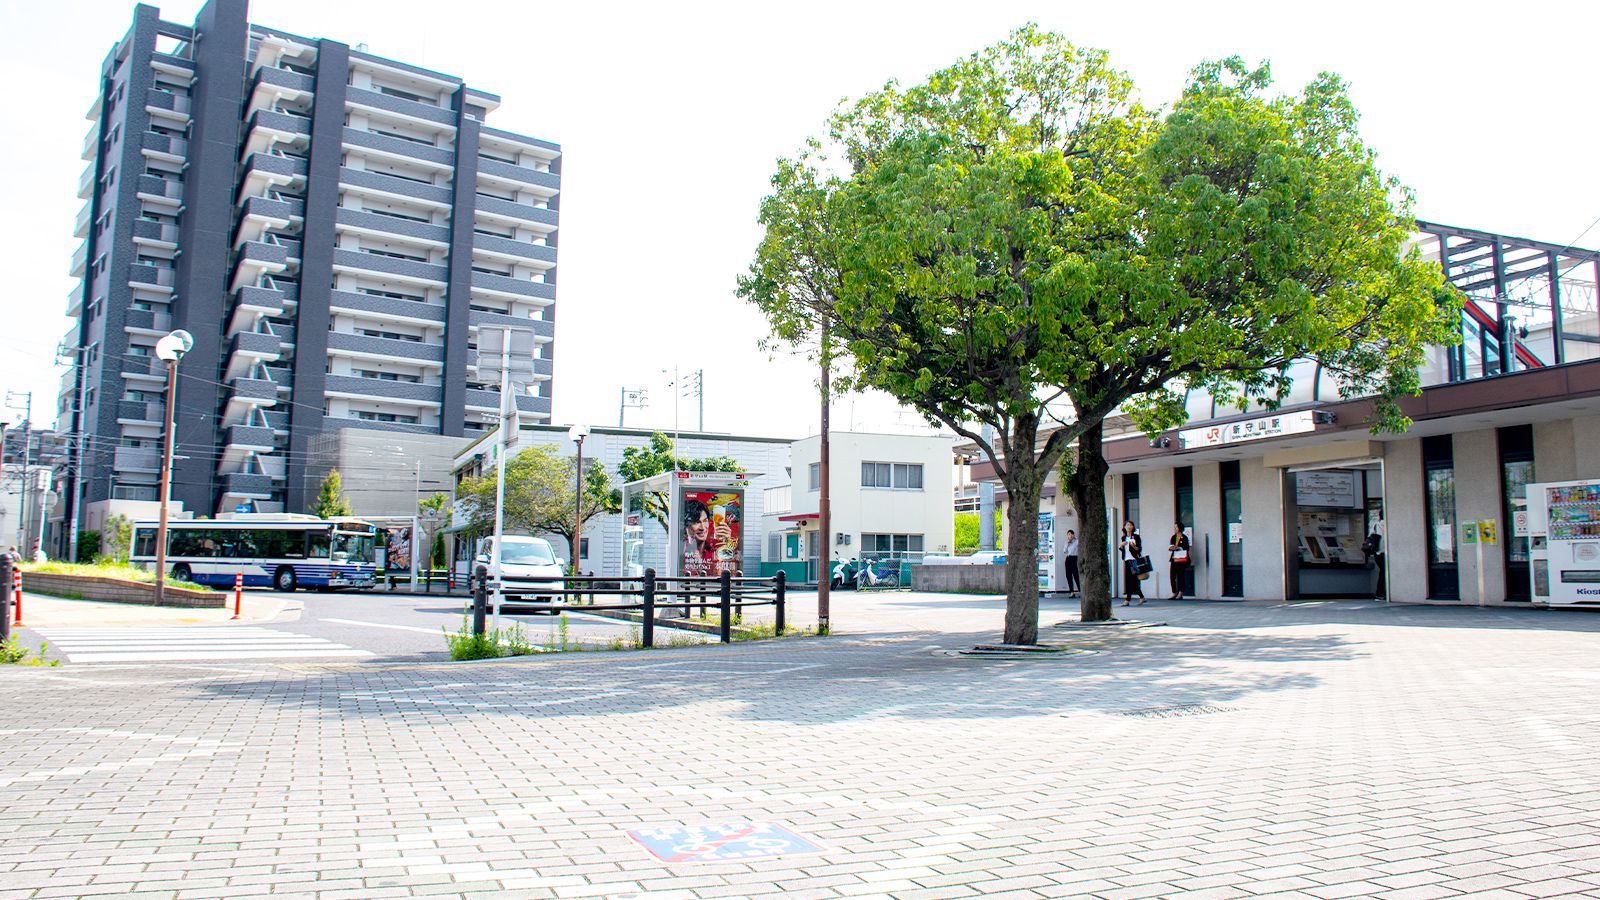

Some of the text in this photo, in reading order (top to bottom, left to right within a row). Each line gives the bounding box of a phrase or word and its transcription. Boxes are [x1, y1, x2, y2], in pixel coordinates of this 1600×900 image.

[1232, 418, 1280, 433] 新守山駅
[1207, 428, 1219, 439] JR
